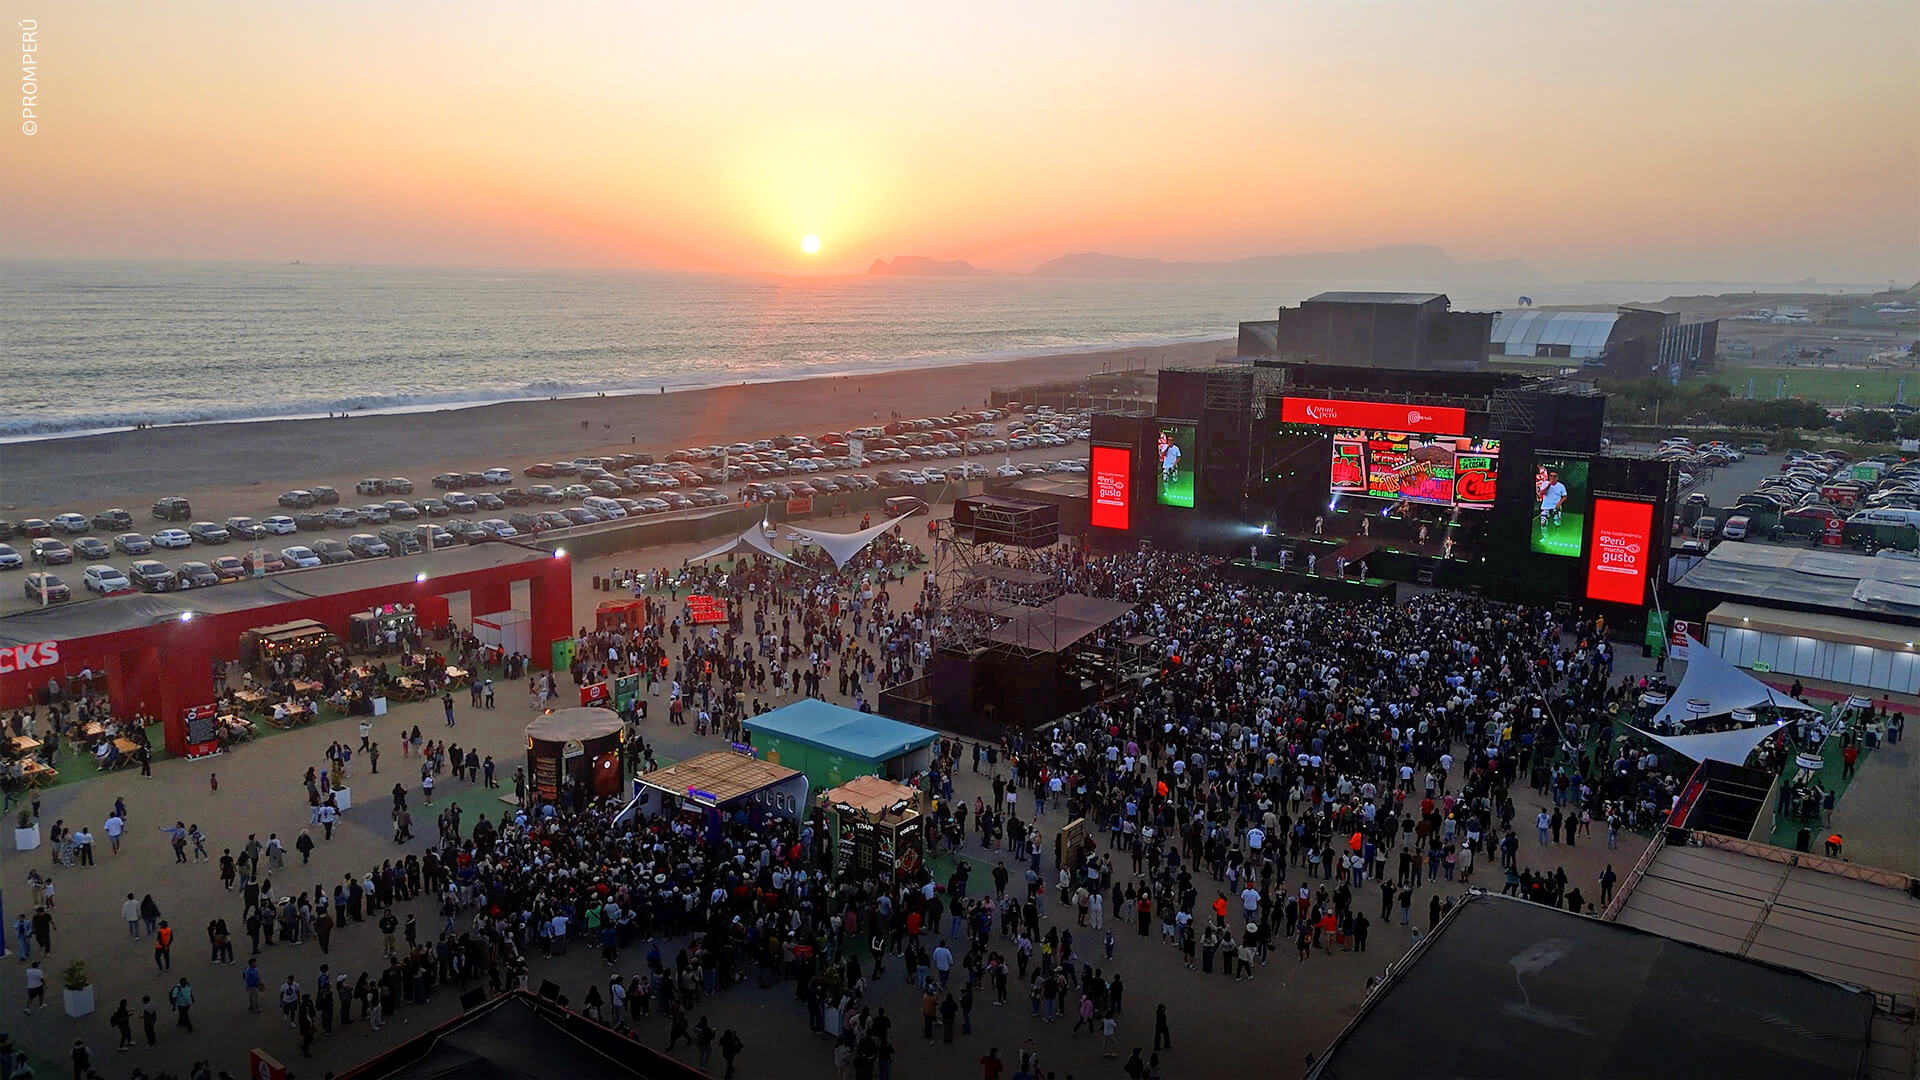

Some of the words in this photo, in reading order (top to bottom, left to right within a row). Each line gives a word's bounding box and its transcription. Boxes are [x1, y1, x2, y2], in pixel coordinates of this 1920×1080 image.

[1100, 489, 1121, 497] gusto
[1600, 536, 1625, 545] Perú
[1603, 552, 1635, 563] gusto
[0, 641, 60, 674] CKS
